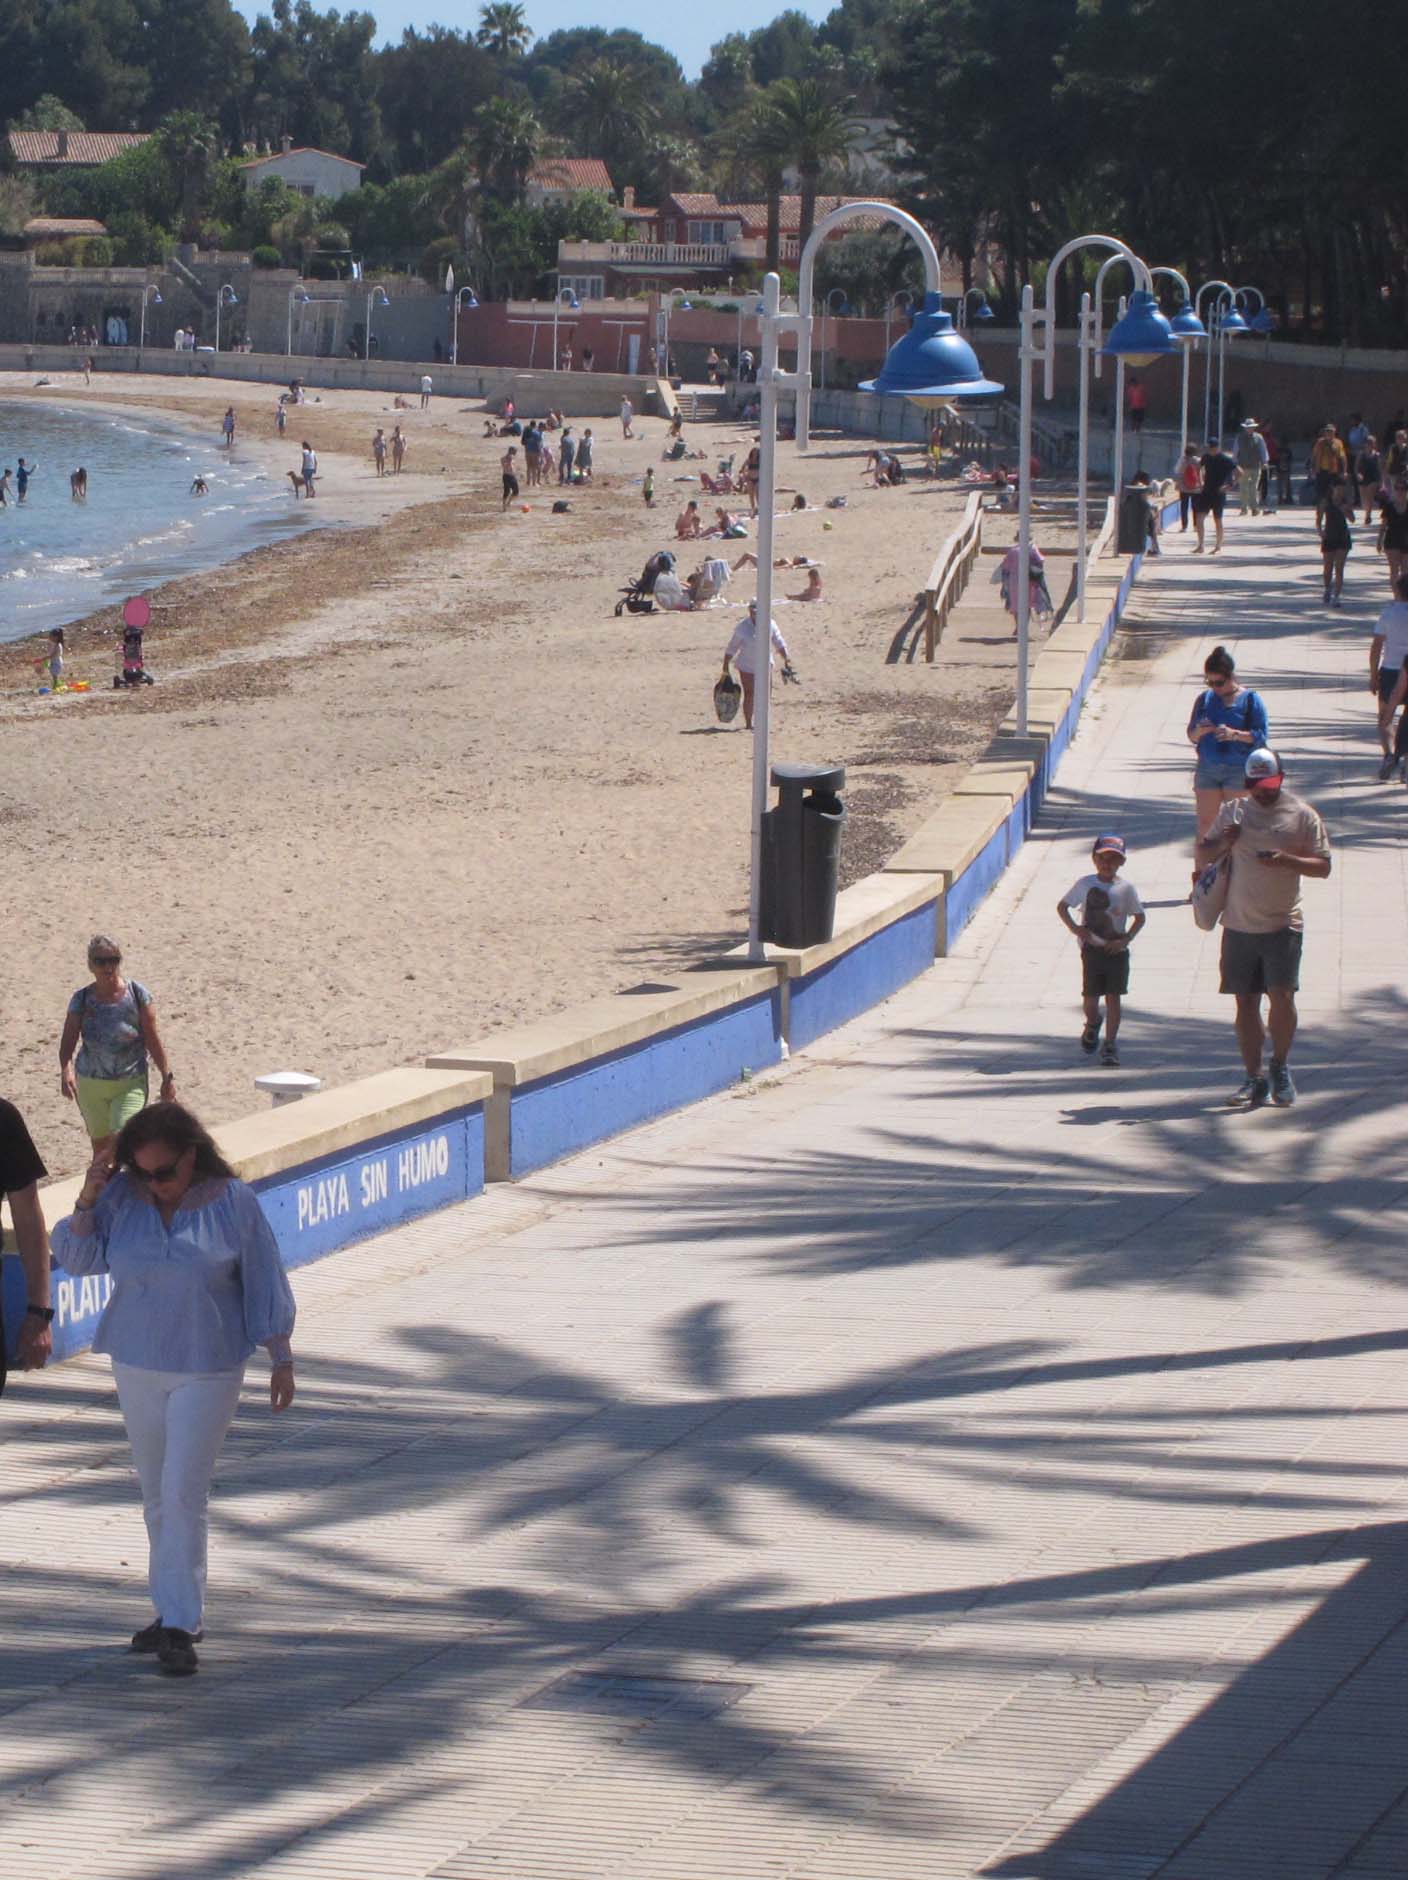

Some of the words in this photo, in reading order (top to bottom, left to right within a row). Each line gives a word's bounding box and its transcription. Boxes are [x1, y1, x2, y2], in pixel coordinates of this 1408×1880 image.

[298, 1173, 350, 1231] PLAYA
[360, 1159, 388, 1208] SIN
[398, 1135, 449, 1193] HUMO
[58, 1273, 115, 1329] PLATJ
